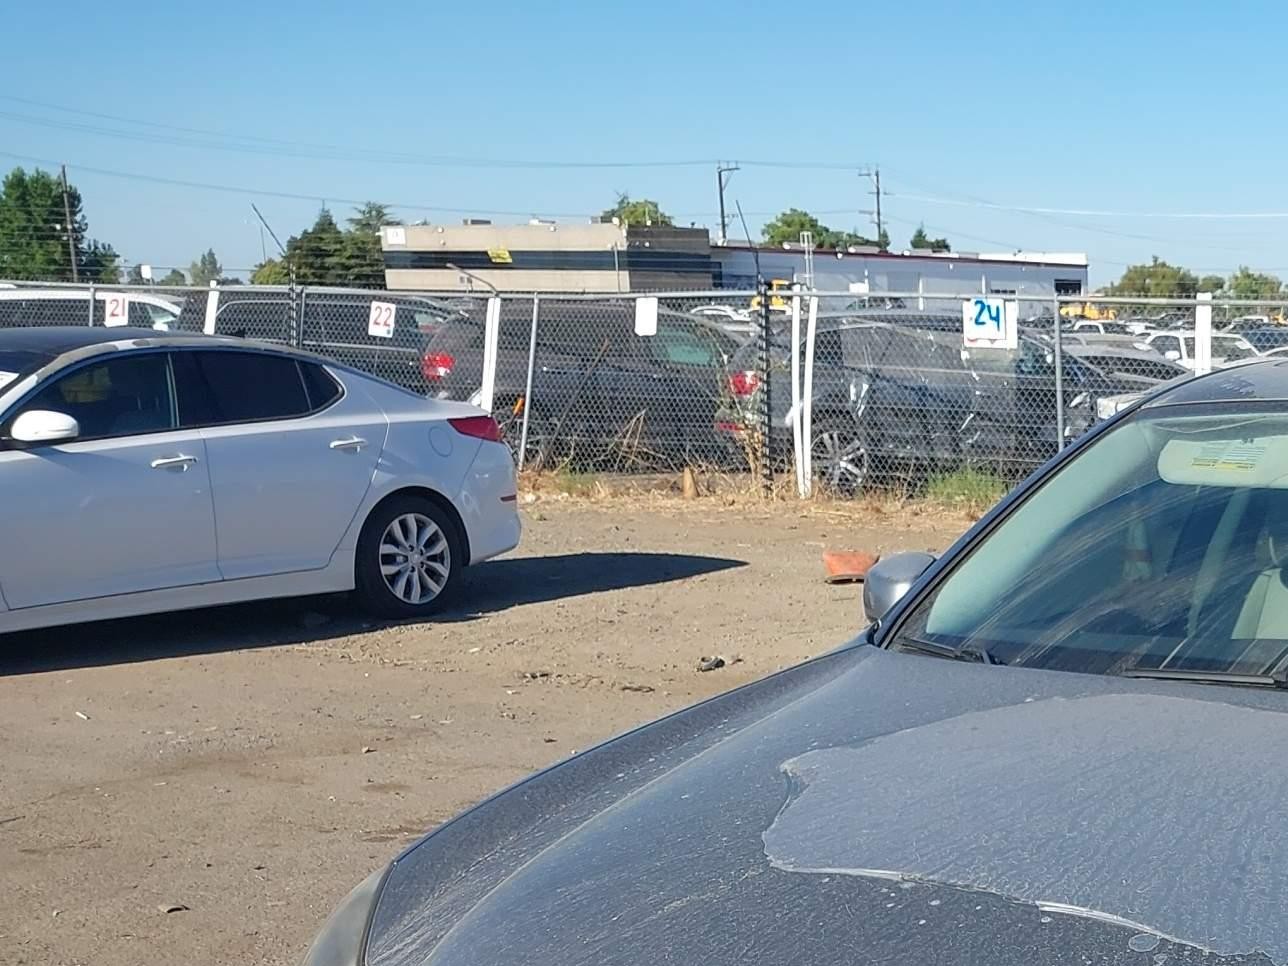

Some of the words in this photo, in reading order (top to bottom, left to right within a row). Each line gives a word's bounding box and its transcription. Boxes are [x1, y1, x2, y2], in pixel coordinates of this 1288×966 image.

[109, 298, 126, 317] 21
[373, 305, 393, 327] 22
[974, 300, 1000, 332] 24
